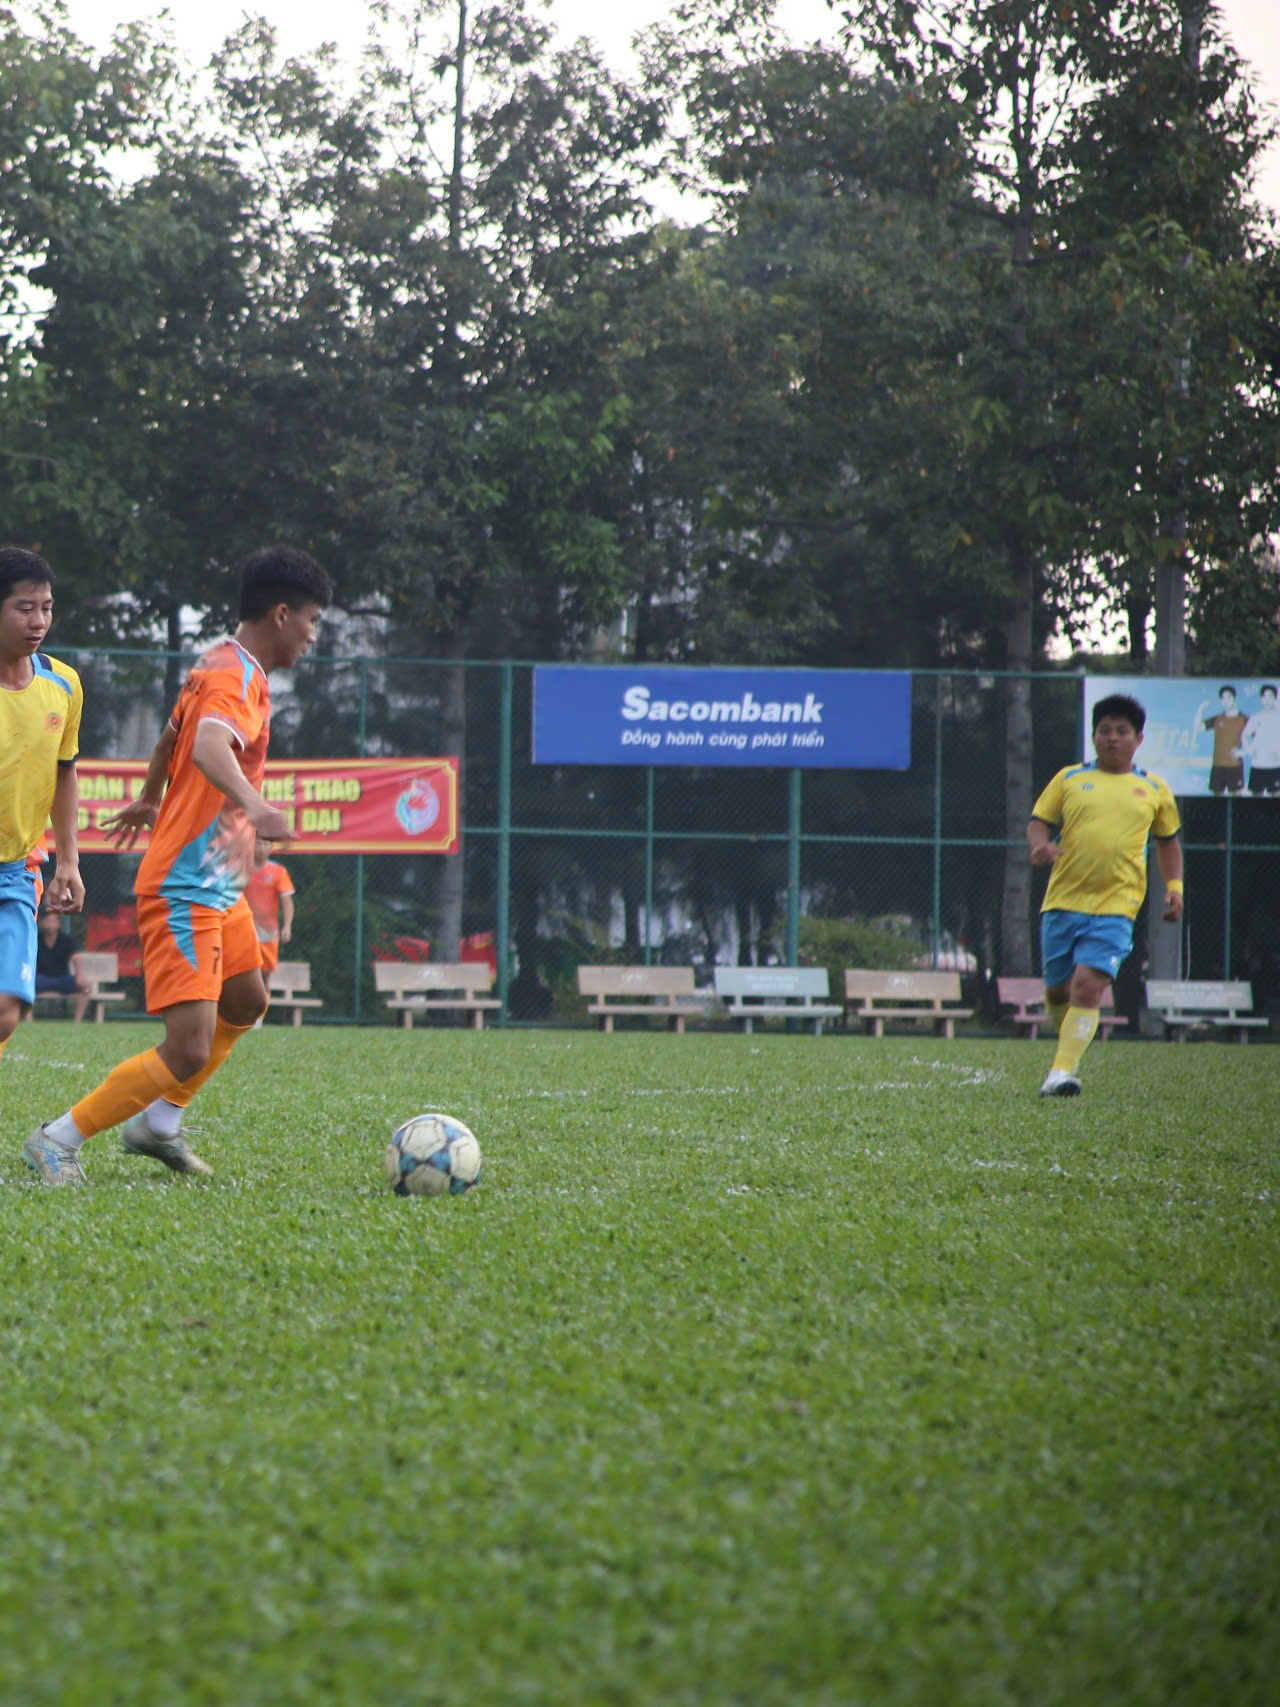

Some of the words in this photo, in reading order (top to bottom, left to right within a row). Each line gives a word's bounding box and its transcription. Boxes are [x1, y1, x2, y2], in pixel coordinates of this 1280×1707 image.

[621, 686, 824, 722] Sacombank
[621, 728, 661, 748] Đồng
[666, 731, 704, 747] hành
[709, 731, 747, 749] cùng
[752, 731, 787, 749] phát
[301, 776, 361, 802] THAO
